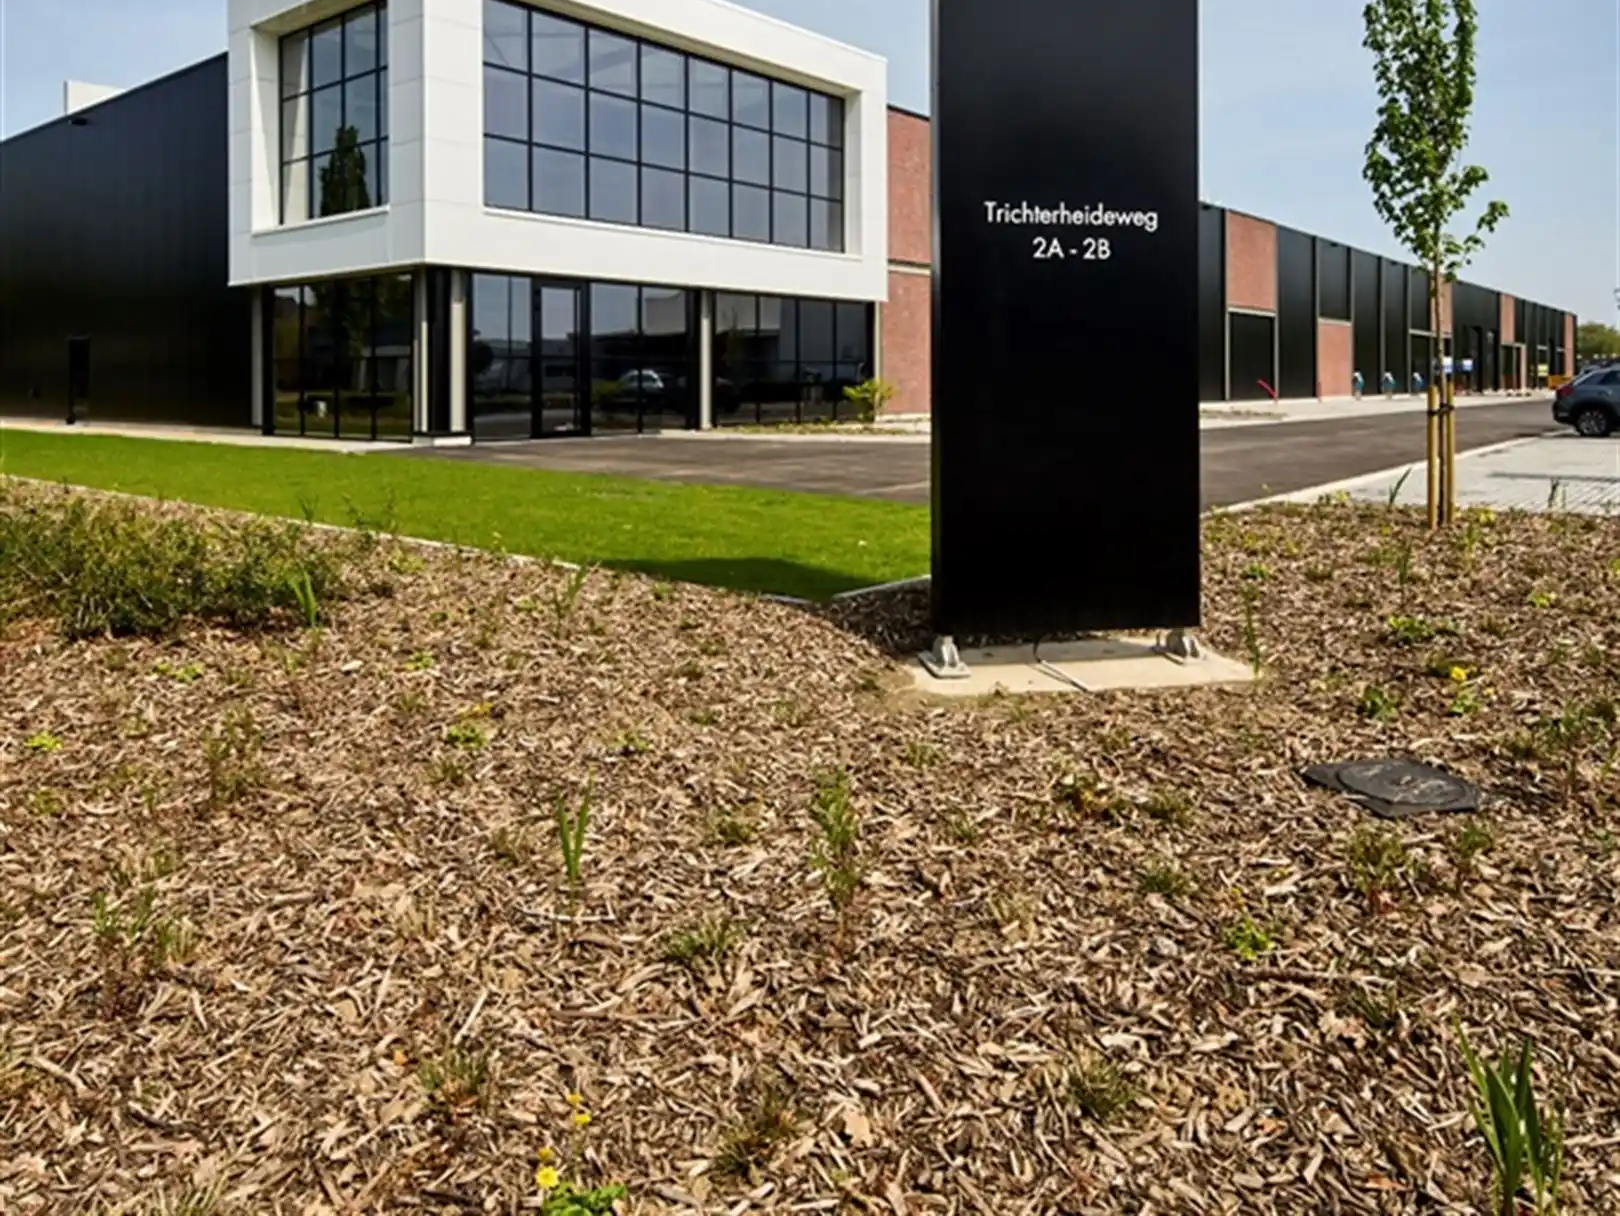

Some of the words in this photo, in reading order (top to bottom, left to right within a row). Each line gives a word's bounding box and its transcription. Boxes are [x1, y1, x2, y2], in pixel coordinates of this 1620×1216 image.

[983, 200, 1159, 232] Trichterheideweg
[1032, 237, 1065, 259] 2A
[1082, 237, 1111, 260] 2B
